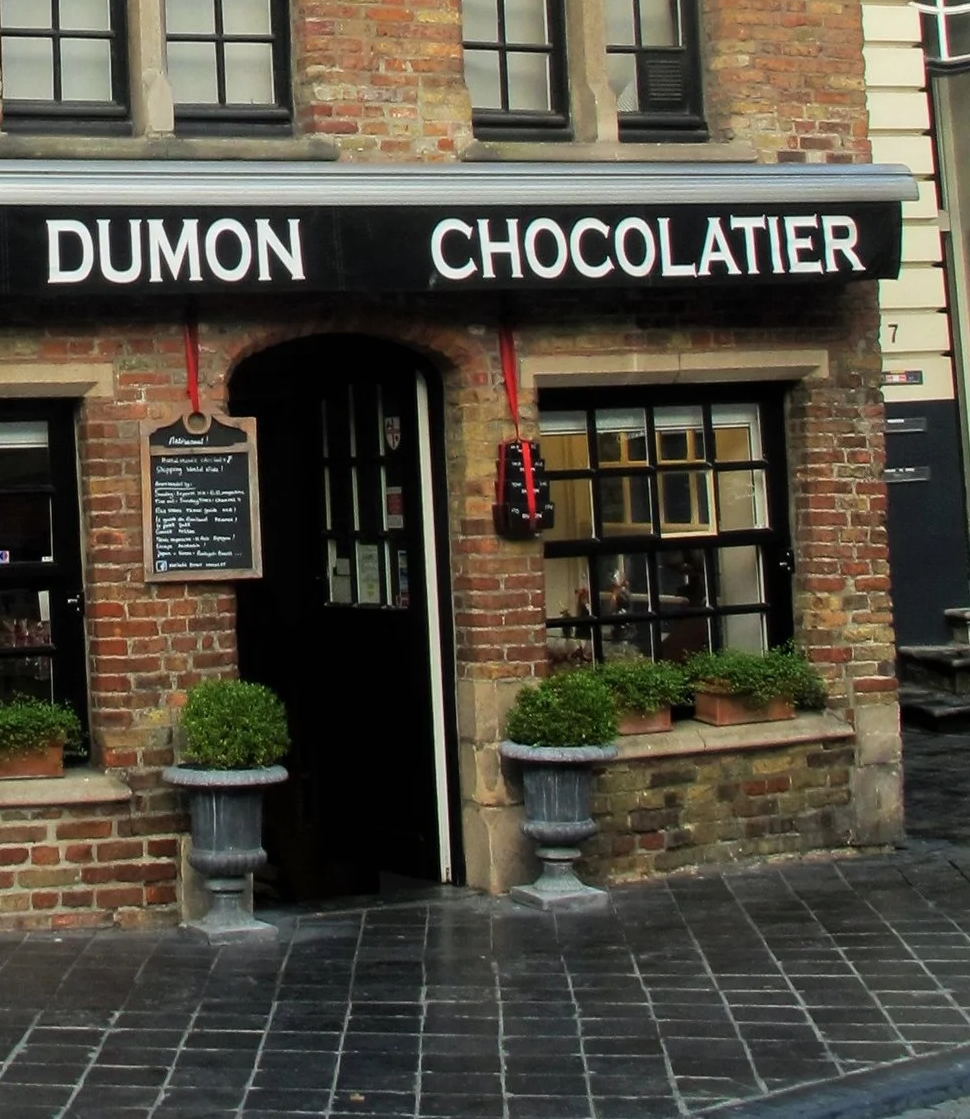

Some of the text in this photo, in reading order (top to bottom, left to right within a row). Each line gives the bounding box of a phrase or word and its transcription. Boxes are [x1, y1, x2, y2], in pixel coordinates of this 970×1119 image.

[45, 218, 306, 284] DUMON
[431, 213, 867, 280] CHOCOLATIER
[887, 323, 899, 344] 7
